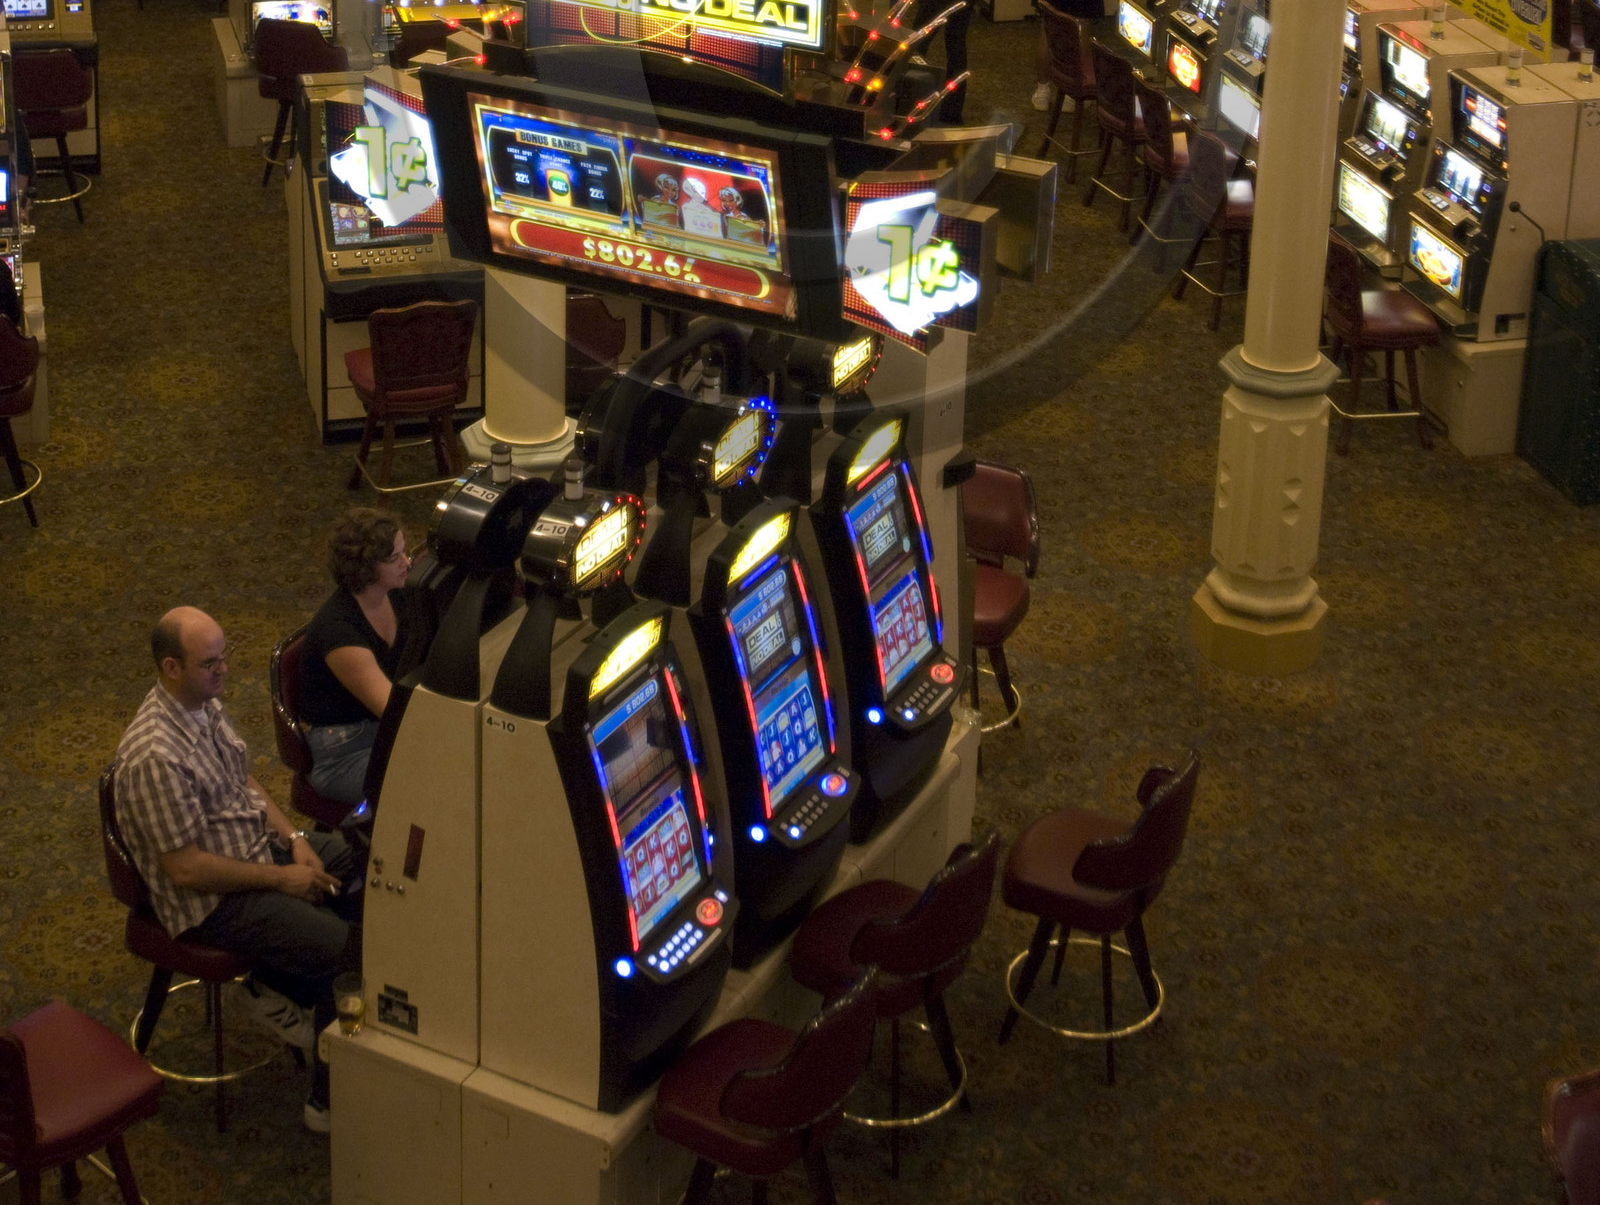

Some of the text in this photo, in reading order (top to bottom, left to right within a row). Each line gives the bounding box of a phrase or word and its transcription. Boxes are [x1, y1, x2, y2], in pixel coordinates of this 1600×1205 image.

[520, 132, 582, 153] BONUS GAMES
[354, 126, 427, 200] 1¢
[877, 224, 960, 306] 1¢
[849, 346, 869, 374] DEAL
[464, 485, 497, 503] 4-10
[536, 524, 567, 535] 4-10
[581, 515, 619, 553] DEAL
[864, 521, 889, 546] DEAL
[867, 532, 896, 565] NO DEAL
[748, 621, 776, 645] DEAL
[751, 634, 784, 666] NO DEAL
[486, 716, 516, 733] 4-10
